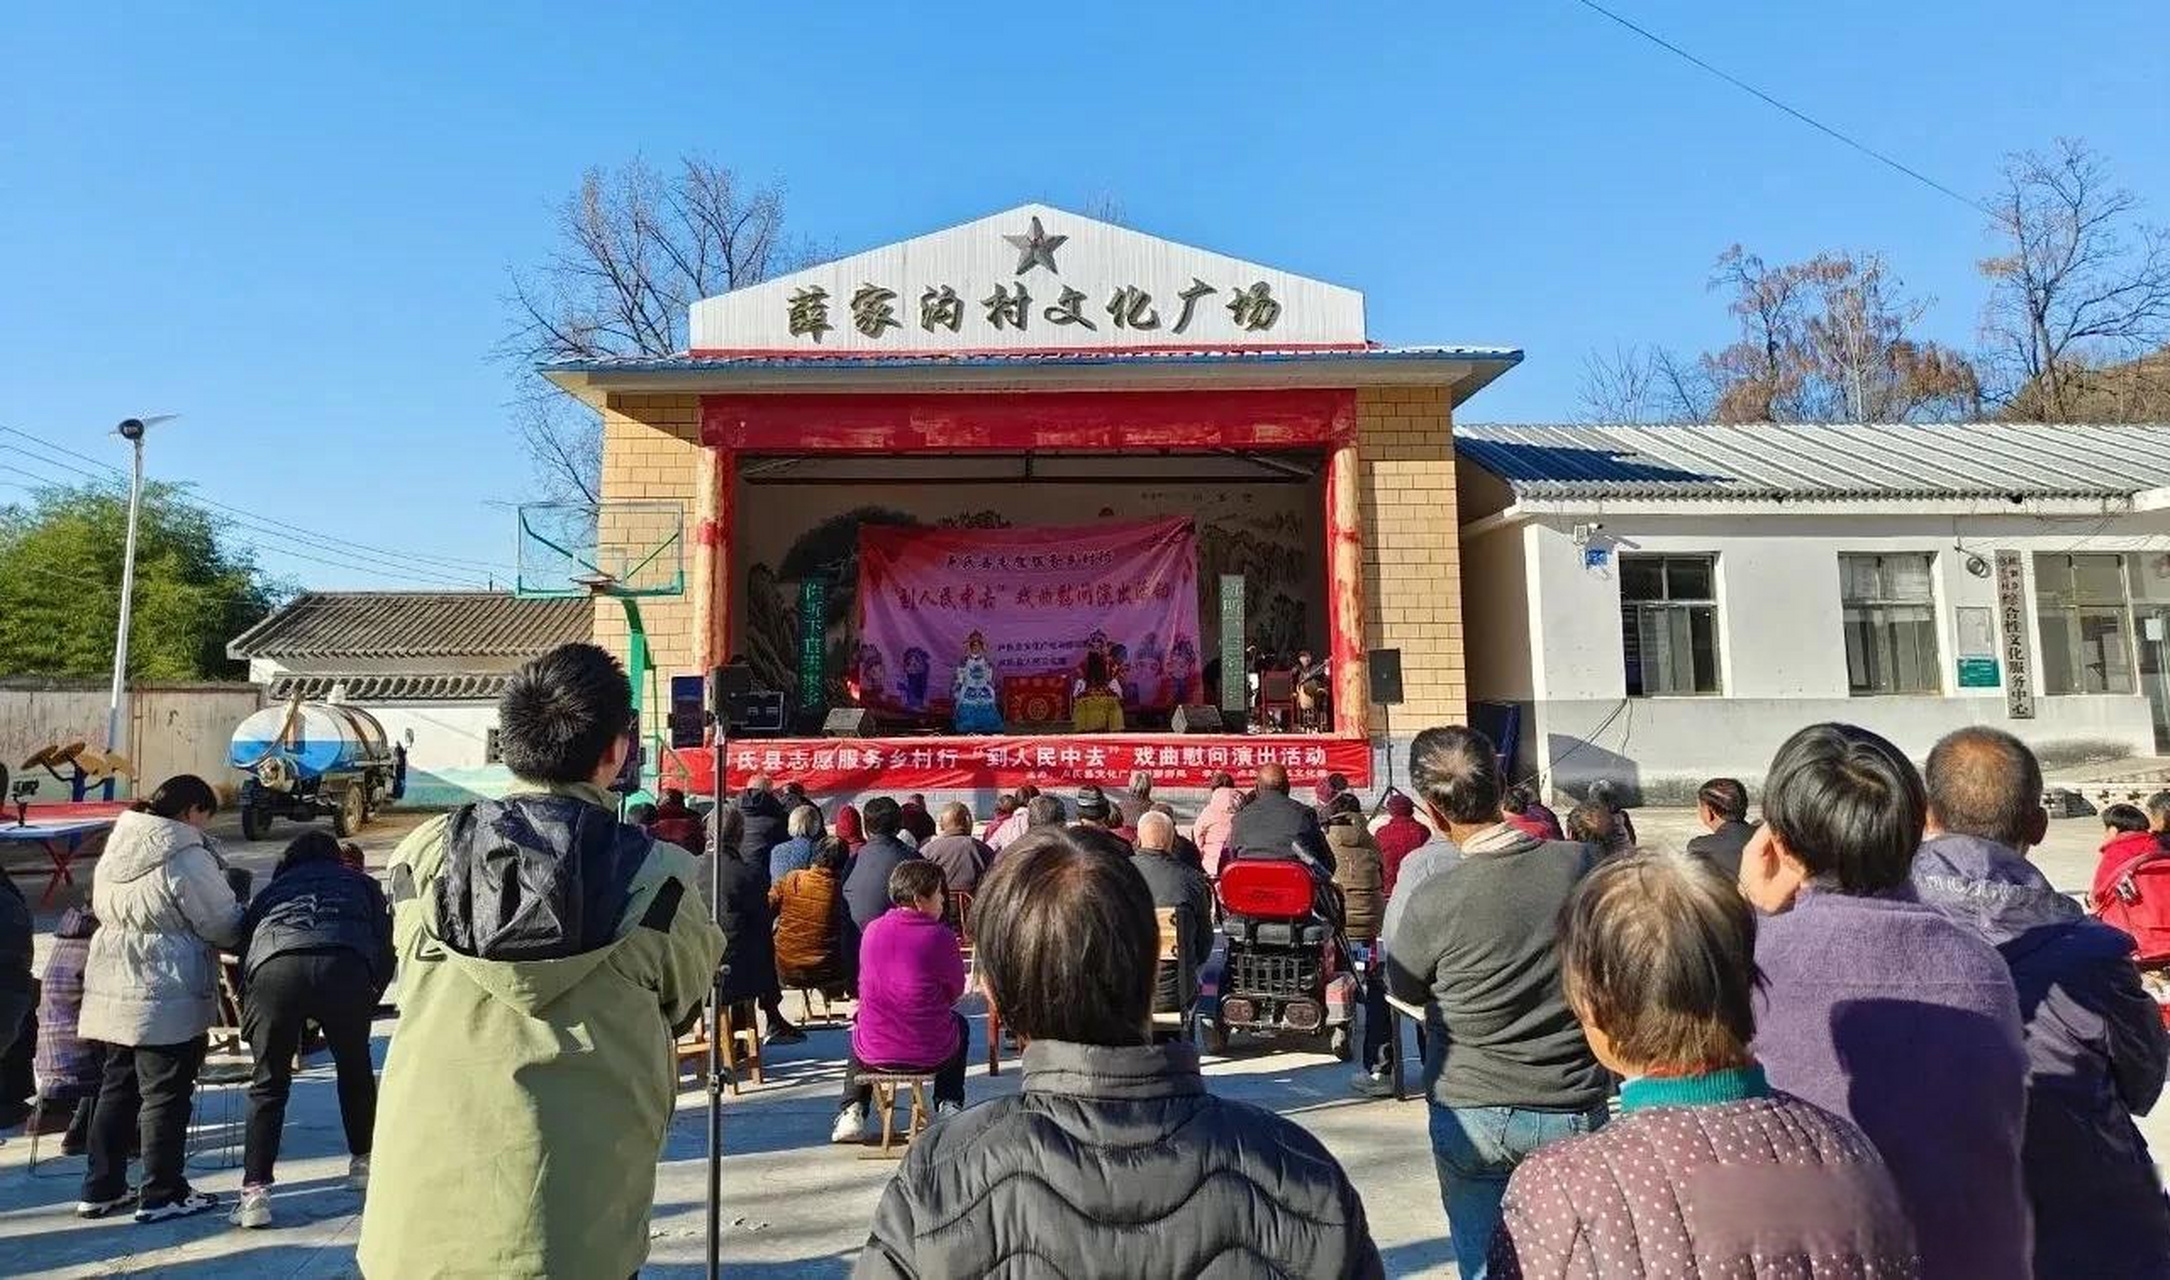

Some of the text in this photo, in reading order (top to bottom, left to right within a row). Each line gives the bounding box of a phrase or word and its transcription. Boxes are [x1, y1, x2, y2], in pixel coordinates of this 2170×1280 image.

[787, 278, 1282, 344] 薛家沟村文化广场
[973, 746, 1119, 768] “到人民中去”
[1133, 745, 1327, 768] 戏曲慰问演出活动
